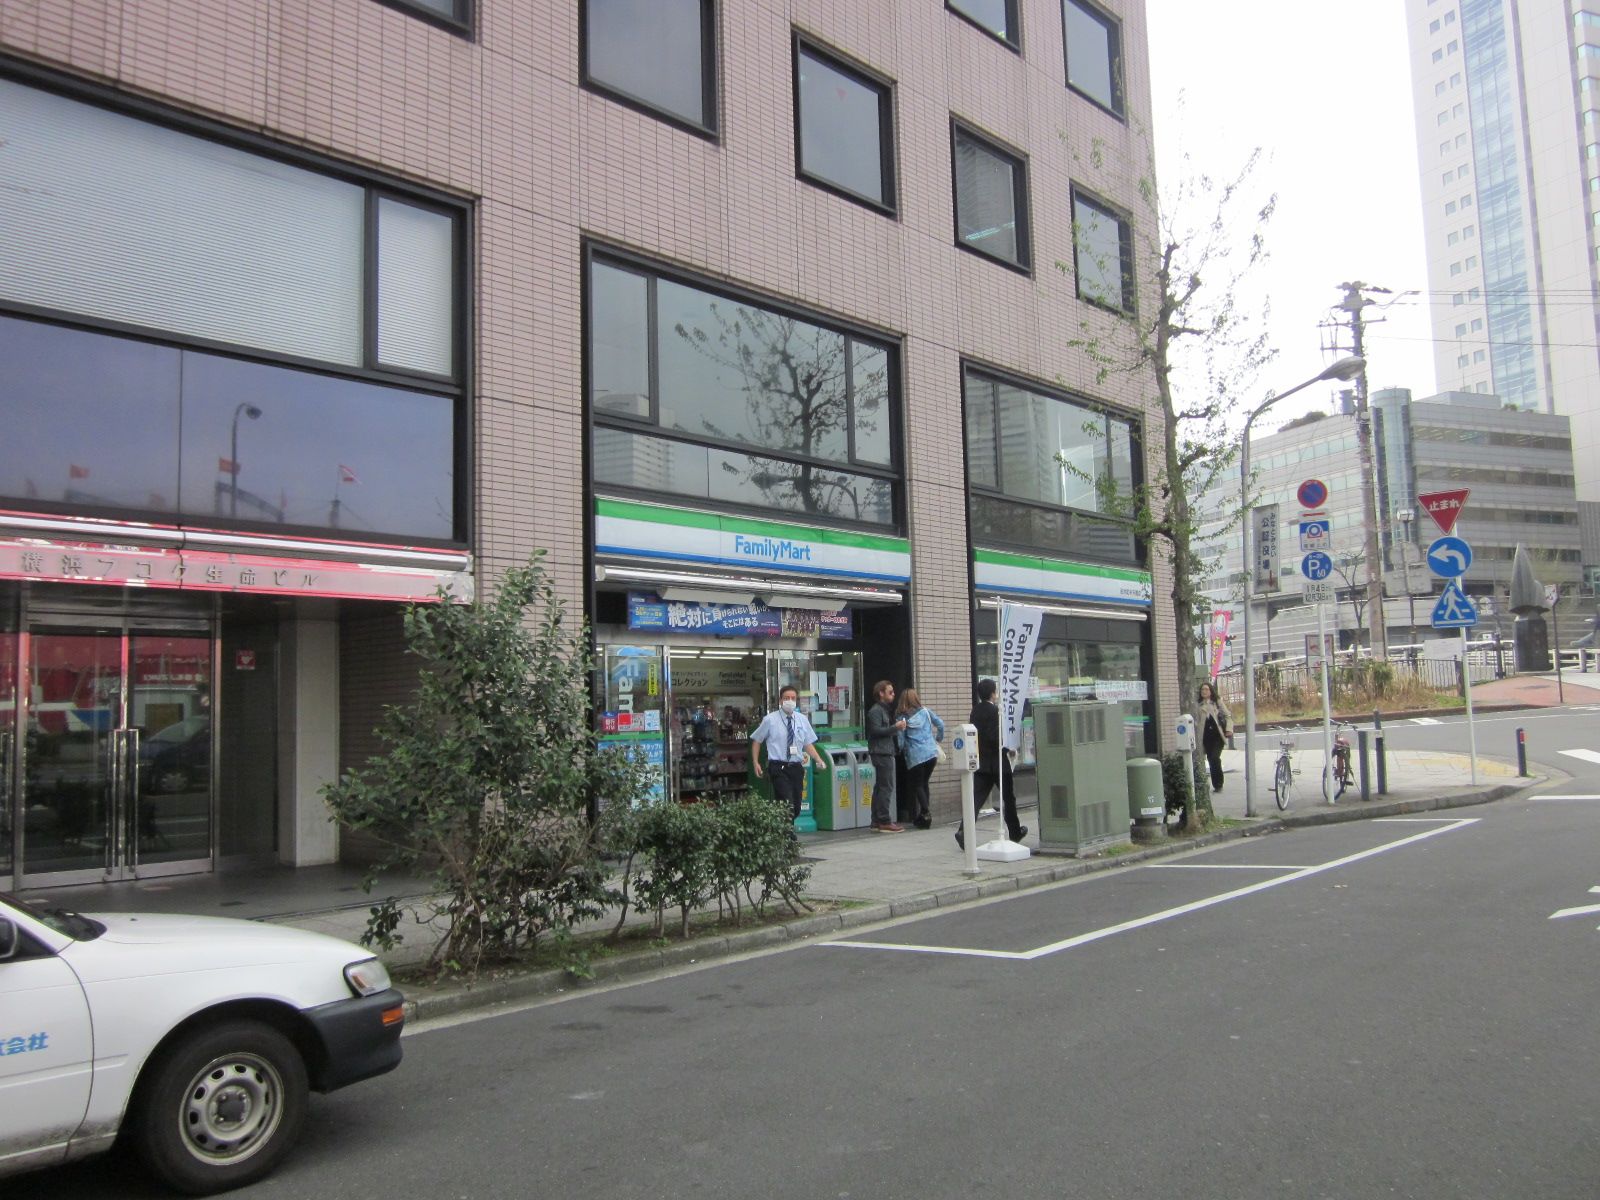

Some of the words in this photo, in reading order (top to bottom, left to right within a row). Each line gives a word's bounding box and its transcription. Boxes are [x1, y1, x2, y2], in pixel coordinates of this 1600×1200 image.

[1429, 499, 1460, 511] 止まれ
[735, 535, 811, 562] FamilyMart
[21, 552, 319, 588] 横浜フコク生命ビル
[1308, 559, 1320, 577] P
[722, 616, 759, 629] そこにはある
[1008, 622, 1034, 735] FamilyMart
